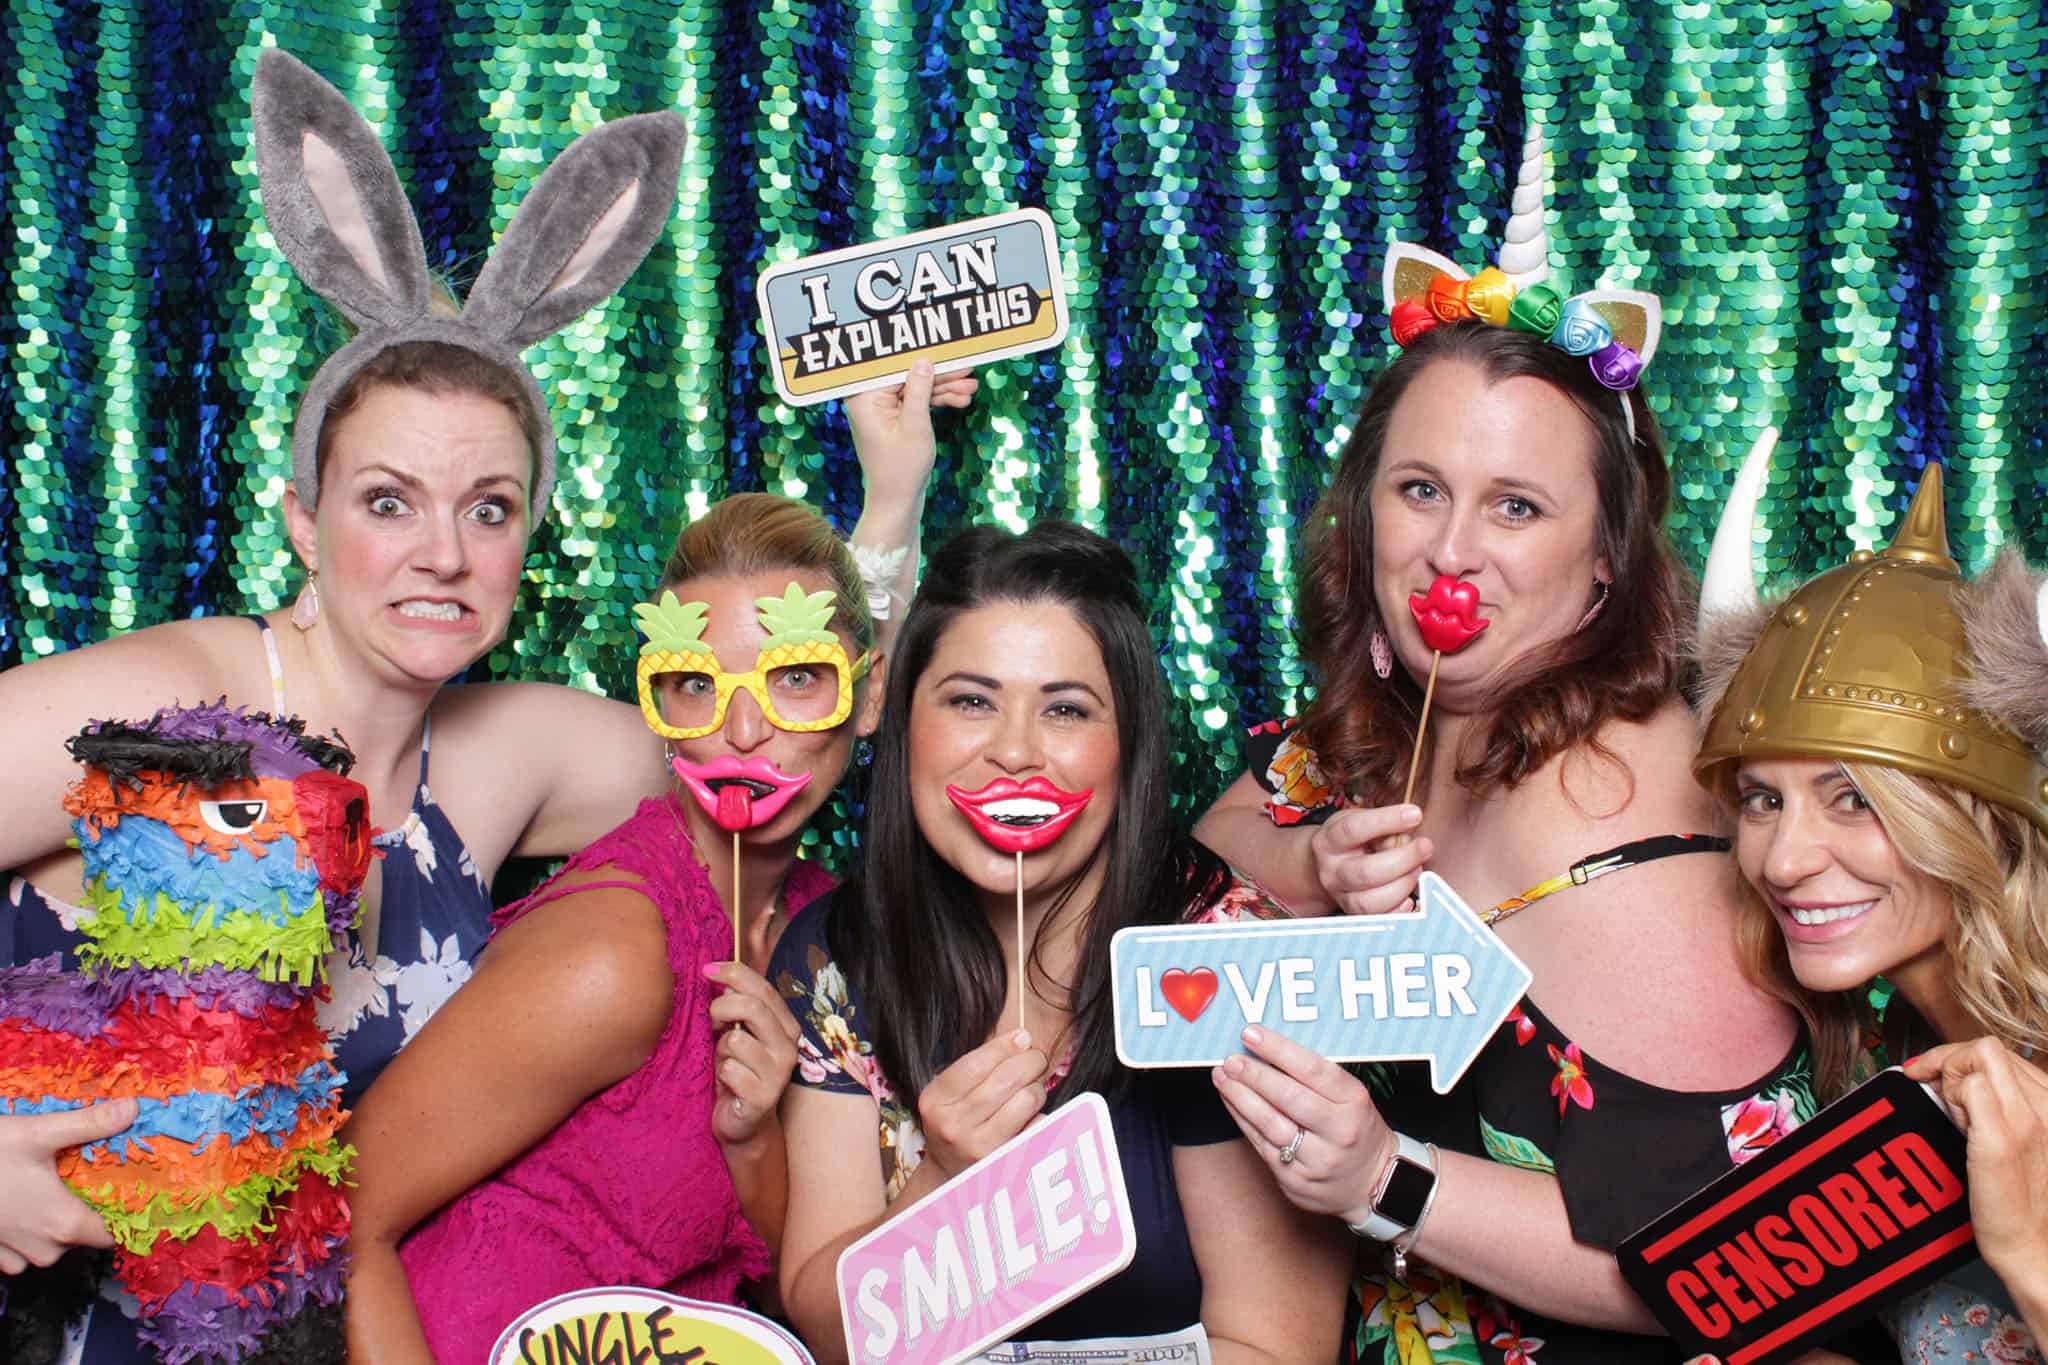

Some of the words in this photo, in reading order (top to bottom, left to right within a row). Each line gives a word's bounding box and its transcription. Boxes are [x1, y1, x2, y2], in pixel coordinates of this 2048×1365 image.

[803, 273, 837, 326] I
[856, 236, 998, 313] CAN
[801, 303, 948, 374] EXPLAIN
[953, 284, 1033, 337] THIS
[1339, 952, 1478, 1020] HER
[856, 1129, 1111, 1358] SMILE!
[1666, 1132, 1964, 1339] CENSORED
[518, 1305, 705, 1365] SINGLE
